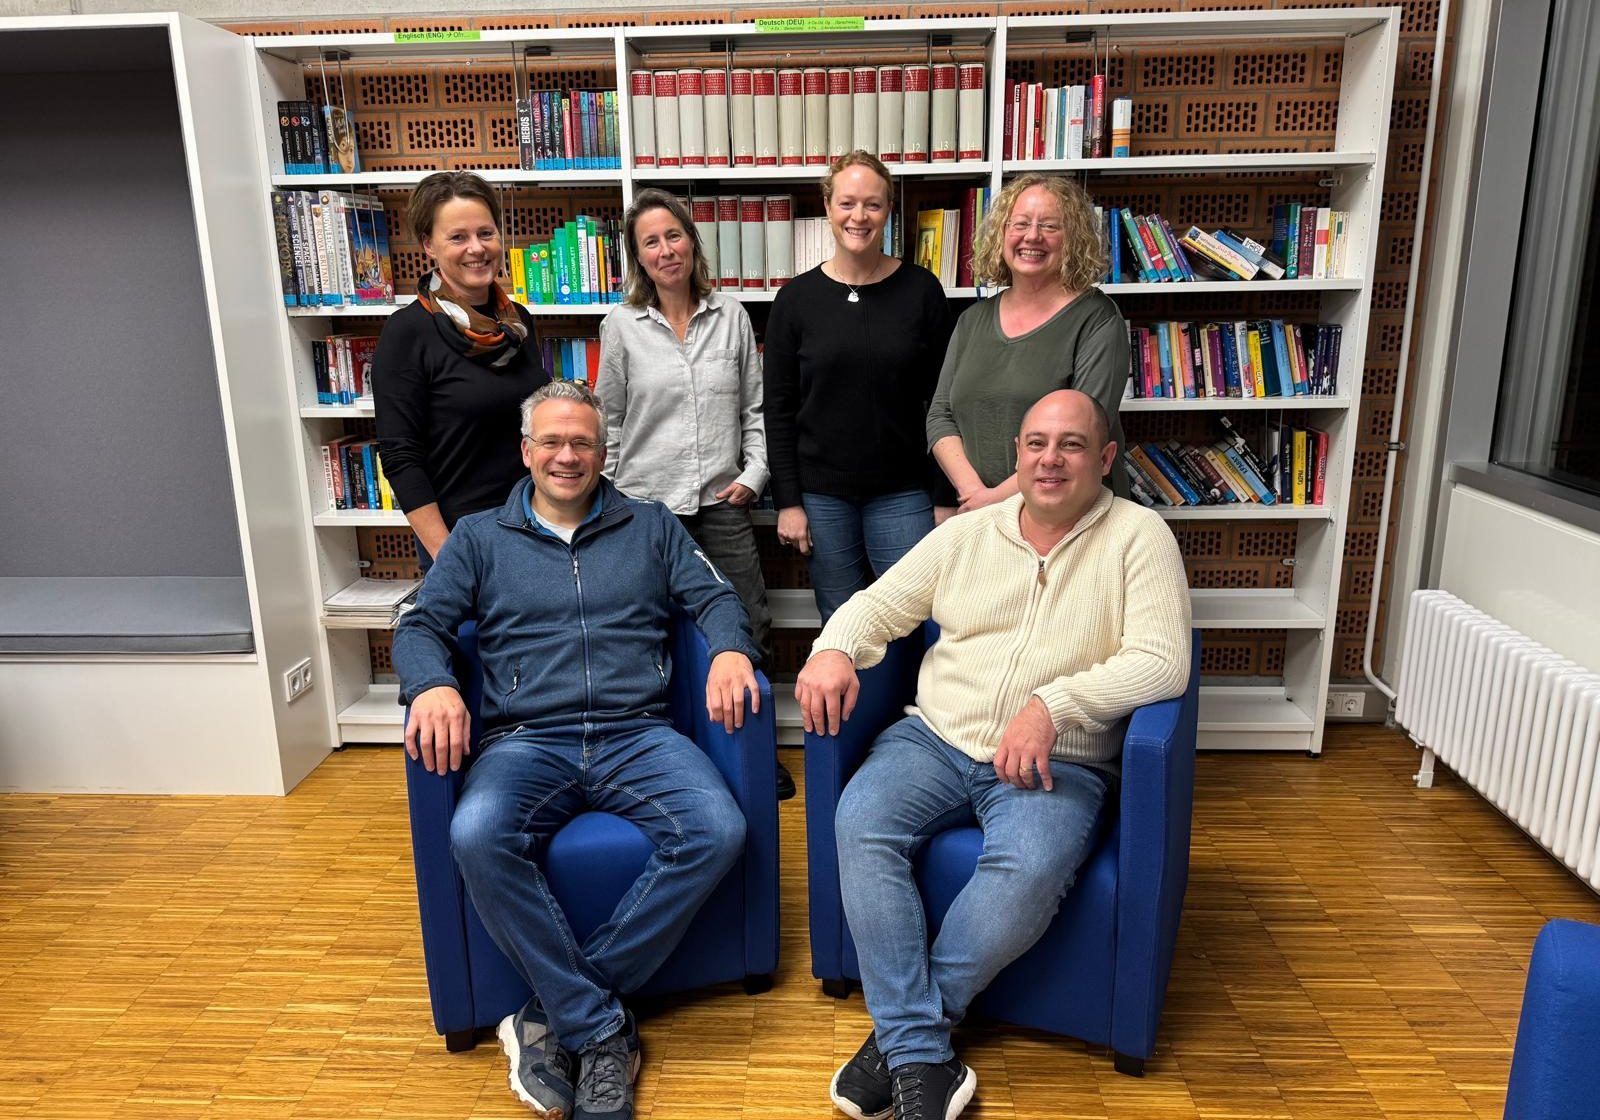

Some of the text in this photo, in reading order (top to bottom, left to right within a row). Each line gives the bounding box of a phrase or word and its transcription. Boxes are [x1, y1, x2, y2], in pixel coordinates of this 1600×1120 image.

[398, 31, 425, 40] Englisch
[426, 31, 444, 40] (ENG)
[520, 116, 531, 144] EREBOS
[322, 207, 335, 255] KNOWLEDGE
[274, 214, 294, 277] HISTORY
[291, 233, 302, 267] SCIENCE!
[302, 241, 311, 266] SPACE!
[316, 228, 329, 286] ROYAL BRITAIN
[1243, 239, 1263, 254] 1984
[725, 268, 734, 277] 18
[748, 269, 758, 278] 19
[775, 269, 786, 277] 20
[1318, 456, 1326, 480] Rebecca
